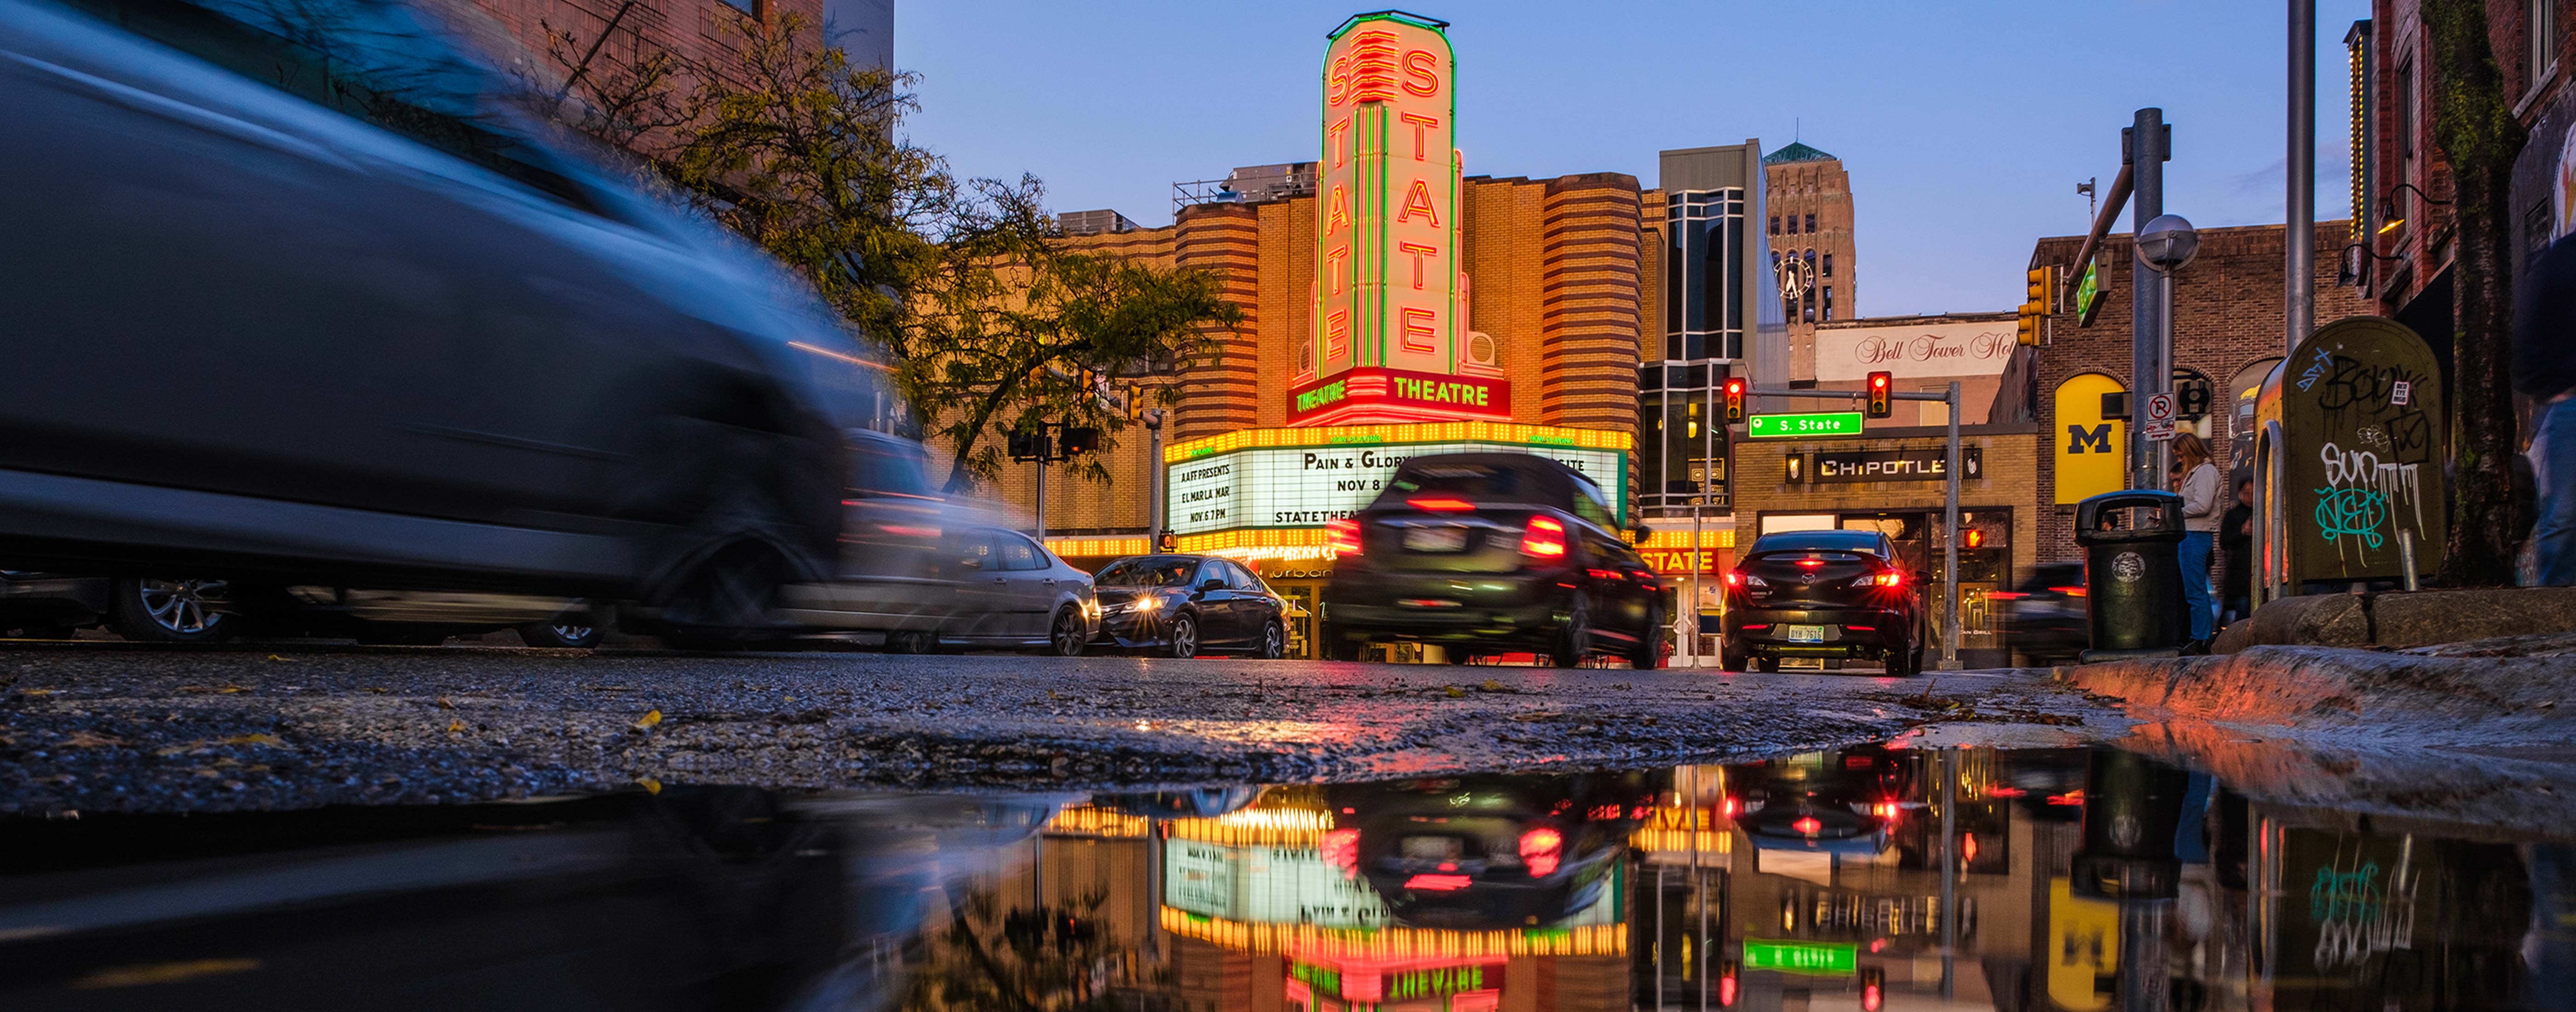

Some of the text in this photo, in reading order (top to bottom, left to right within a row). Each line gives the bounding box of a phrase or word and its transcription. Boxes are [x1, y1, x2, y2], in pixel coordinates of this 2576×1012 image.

[1327, 55, 1351, 361] STATE
[1398, 49, 1440, 354] STATE
[1855, 336, 1904, 364] Bell
[1909, 334, 1965, 362] Tower
[1296, 380, 1346, 413] THEATRE
[1393, 377, 1489, 407] THEATRE
[1780, 419, 1840, 431] S. State
[2068, 424, 2111, 454] M
[1198, 464, 1230, 480] PRESENTS
[1345, 458, 1353, 469] &
[1337, 479, 1380, 491] NOV 8
[1182, 486, 1230, 504] EL MAR LA MAR
[1190, 508, 1225, 523] NOV 6 7 PM
[1640, 552, 1713, 571] STATE
[1272, 568, 1334, 578] urban
